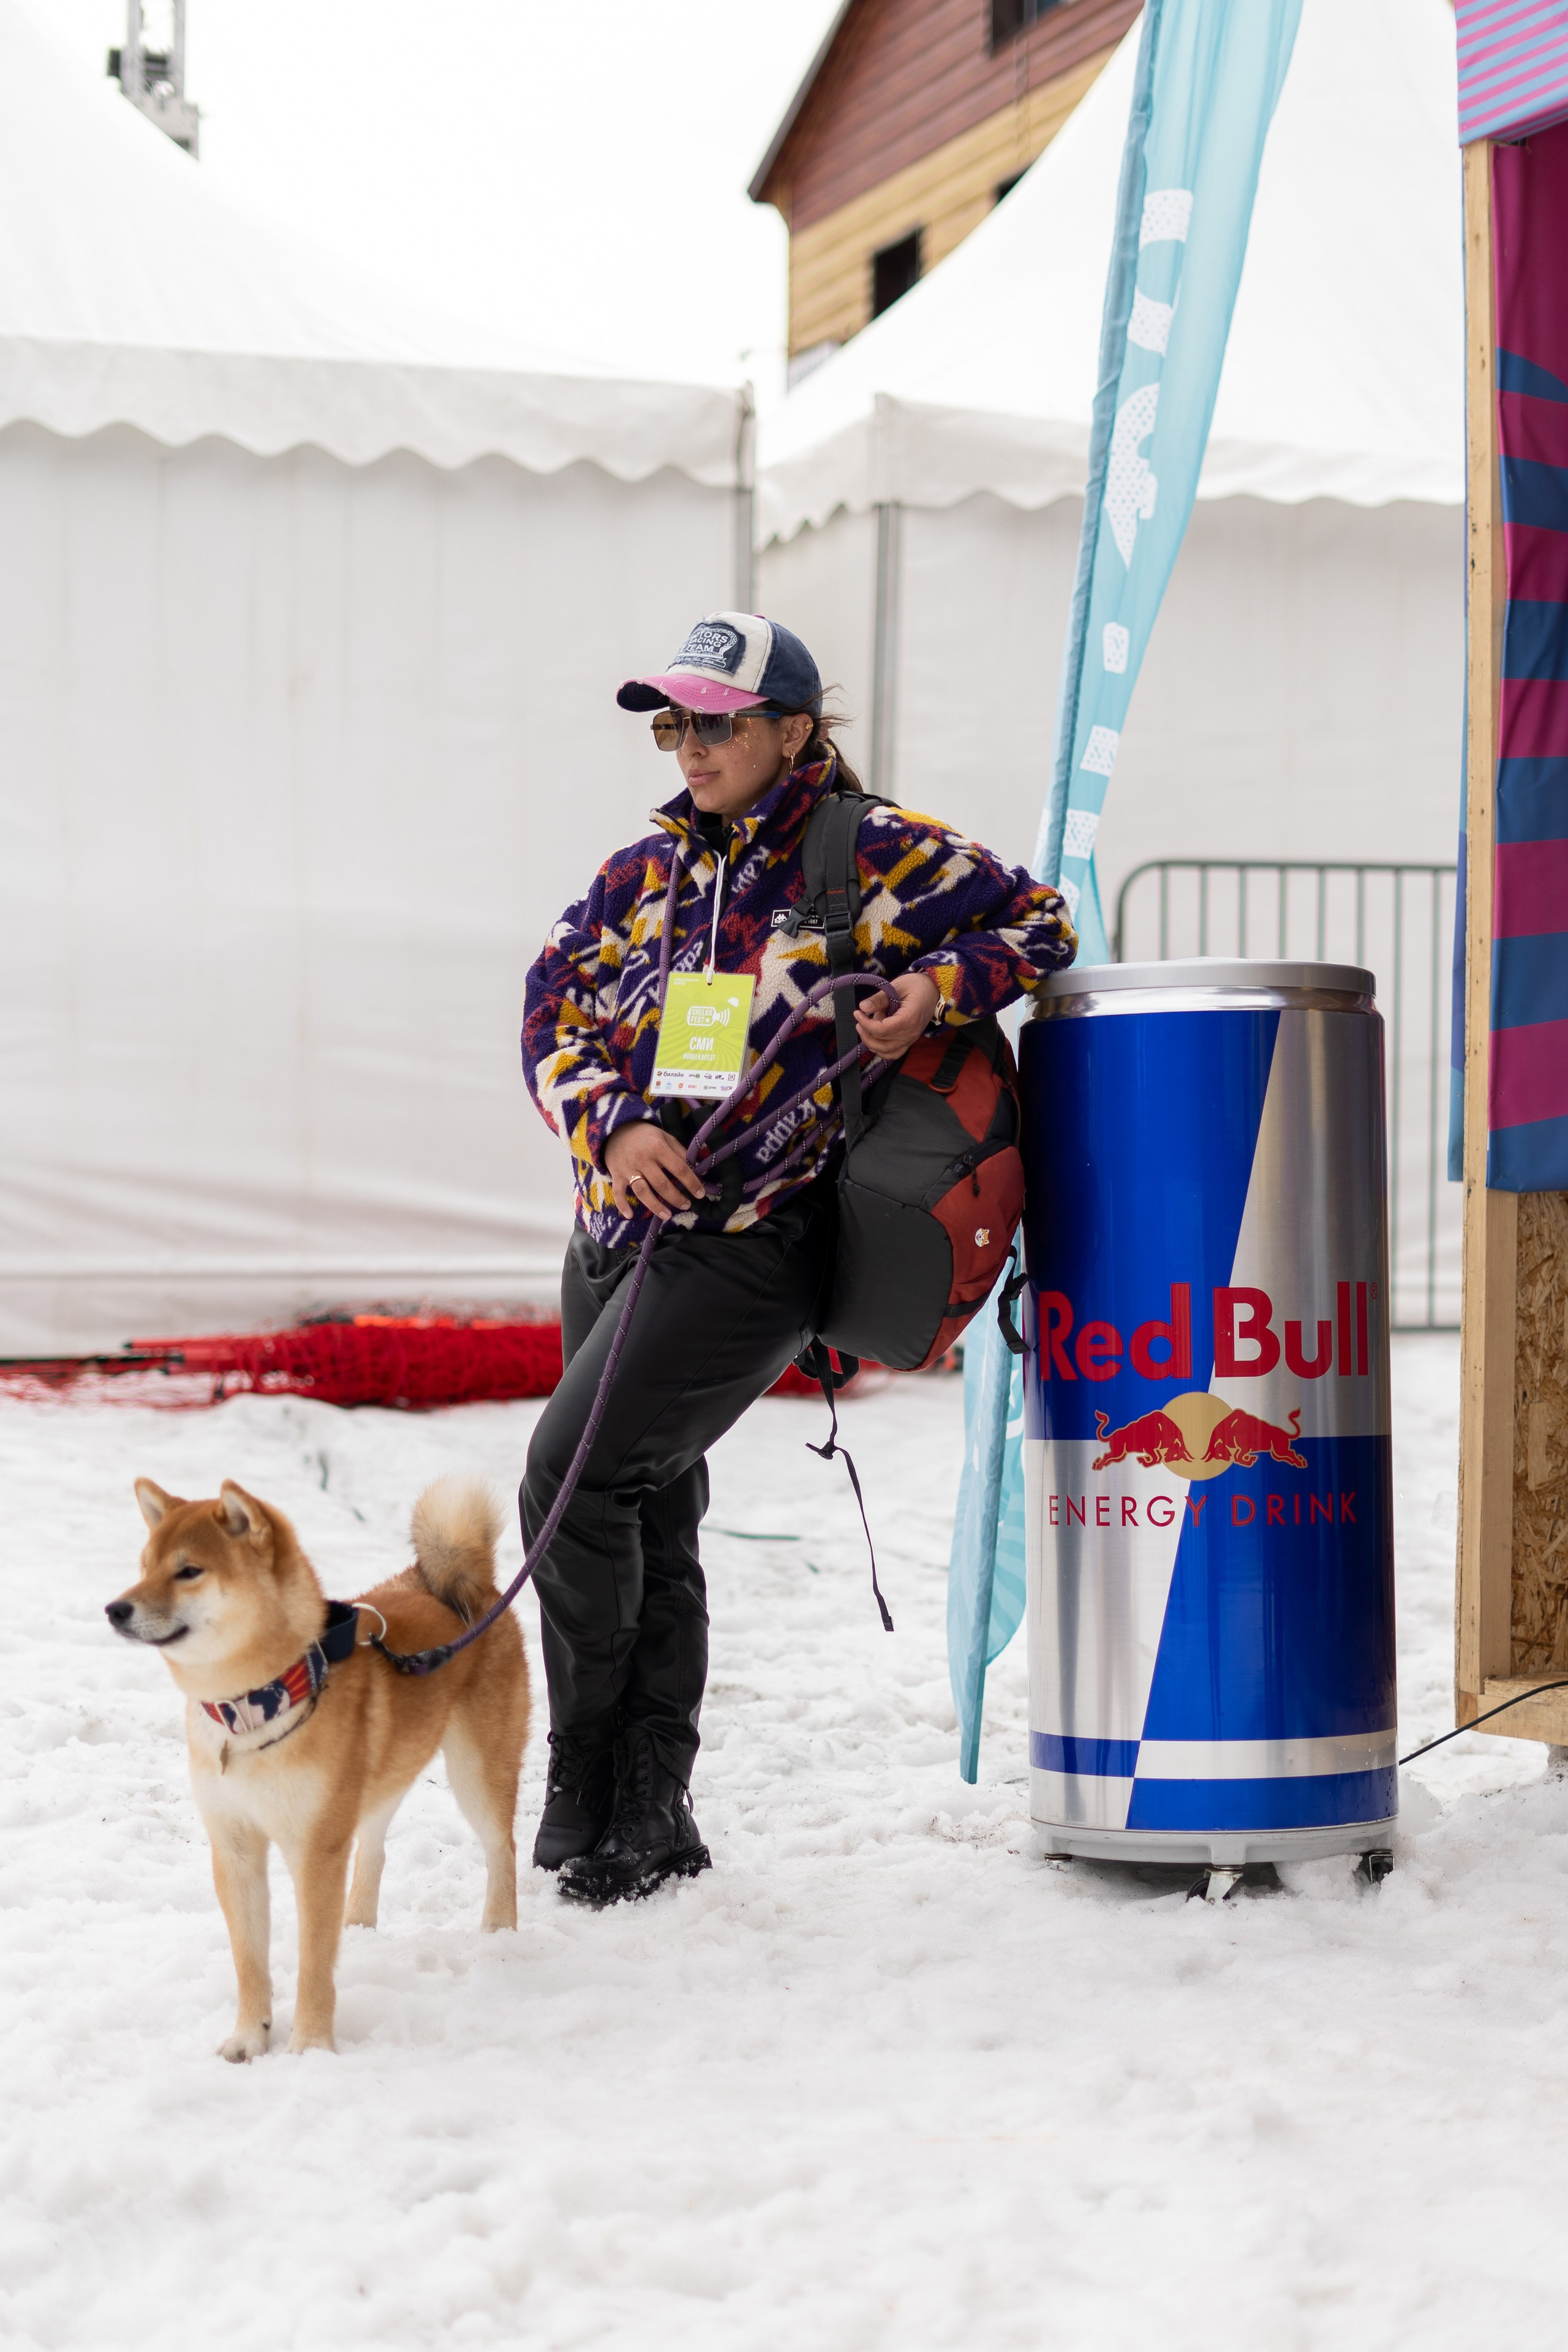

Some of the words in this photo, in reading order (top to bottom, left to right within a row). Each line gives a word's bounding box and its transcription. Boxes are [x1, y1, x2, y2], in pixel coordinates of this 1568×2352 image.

[687, 644, 714, 652] TEAM
[689, 1036, 714, 1050] СМИ
[1038, 1281, 1193, 1381] Red
[1049, 1494, 1209, 1528] ENERGY
[1232, 1491, 1358, 1527] DRINK
